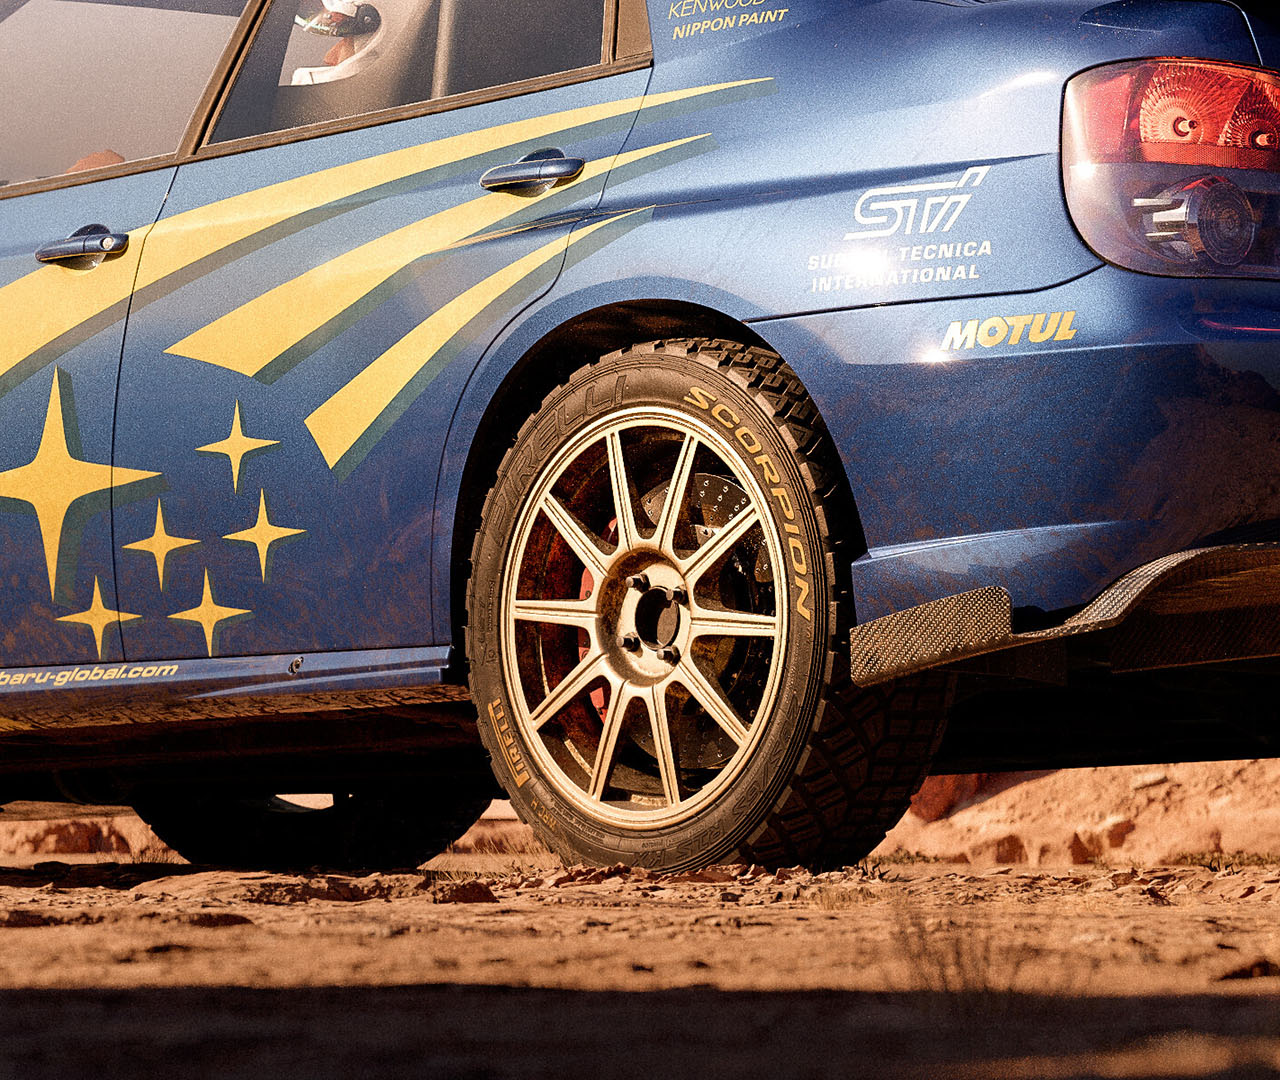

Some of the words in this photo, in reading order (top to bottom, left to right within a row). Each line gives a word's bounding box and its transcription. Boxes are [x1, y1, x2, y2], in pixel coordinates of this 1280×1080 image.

[672, 16, 736, 40] NIPPON
[738, 9, 789, 26] PAINT
[898, 240, 992, 262] TECNICA
[940, 310, 1078, 351] MOTUL
[684, 386, 811, 621] SCORPION
[488, 697, 531, 788] PIRELLI
